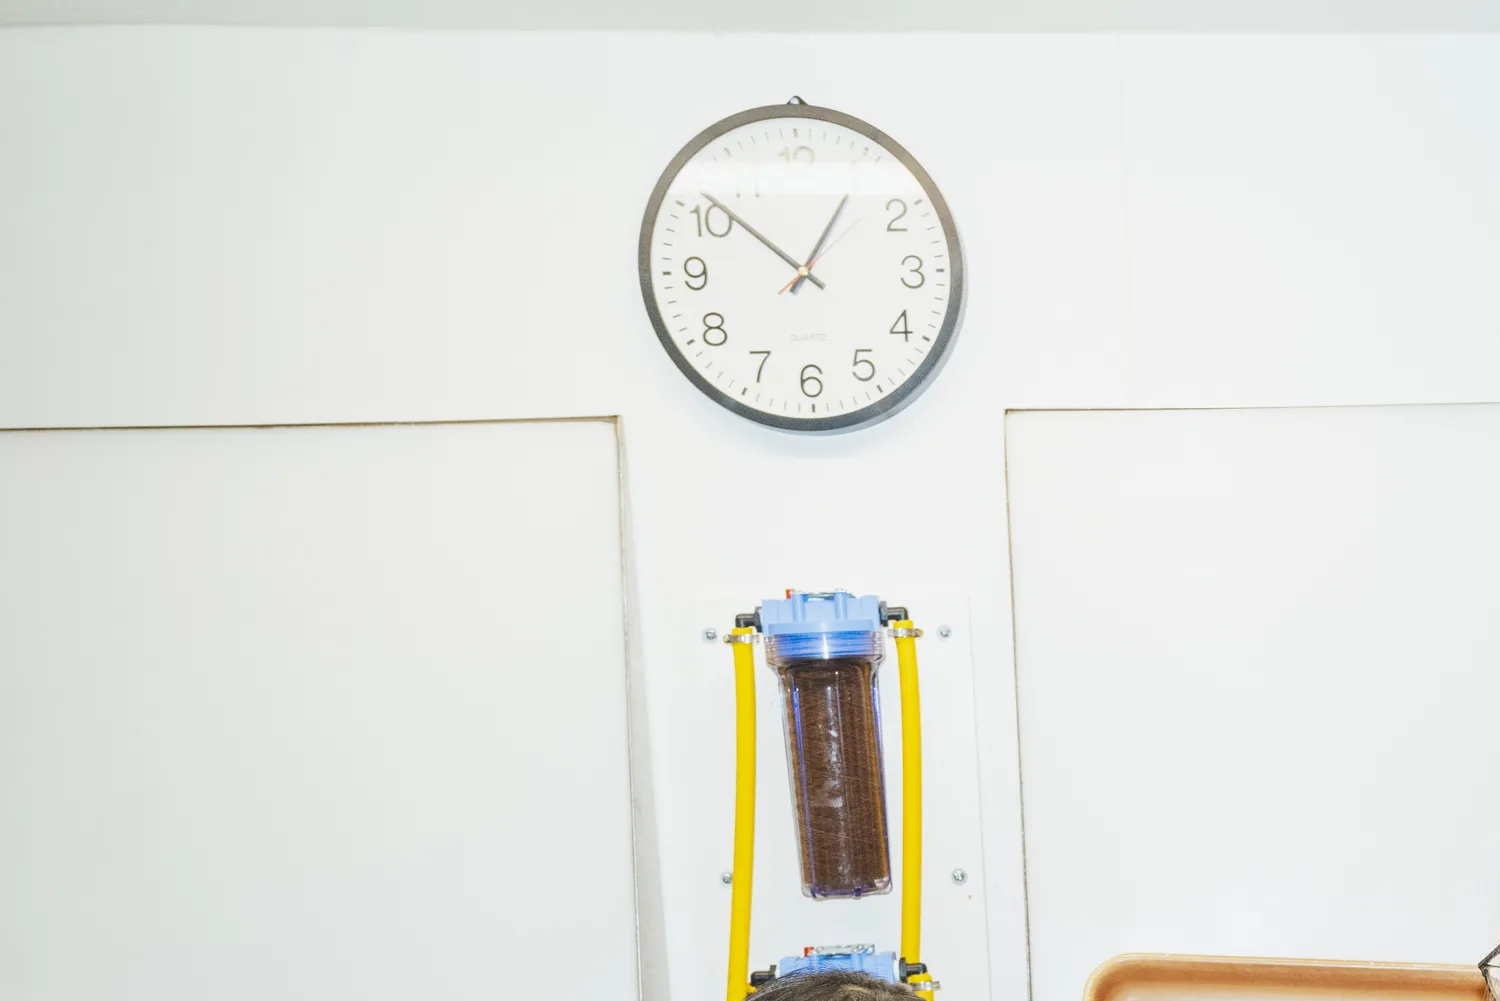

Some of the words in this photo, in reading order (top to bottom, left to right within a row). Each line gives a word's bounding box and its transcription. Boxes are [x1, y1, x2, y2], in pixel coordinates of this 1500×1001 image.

[690, 203, 733, 238] 10
[886, 198, 908, 232] 2
[684, 256, 708, 291] 9
[900, 255, 925, 289] 3
[703, 312, 728, 346] 8
[889, 309, 914, 342] 4
[749, 350, 772, 383] 7
[800, 364, 823, 398] 6
[852, 349, 876, 382] 5
